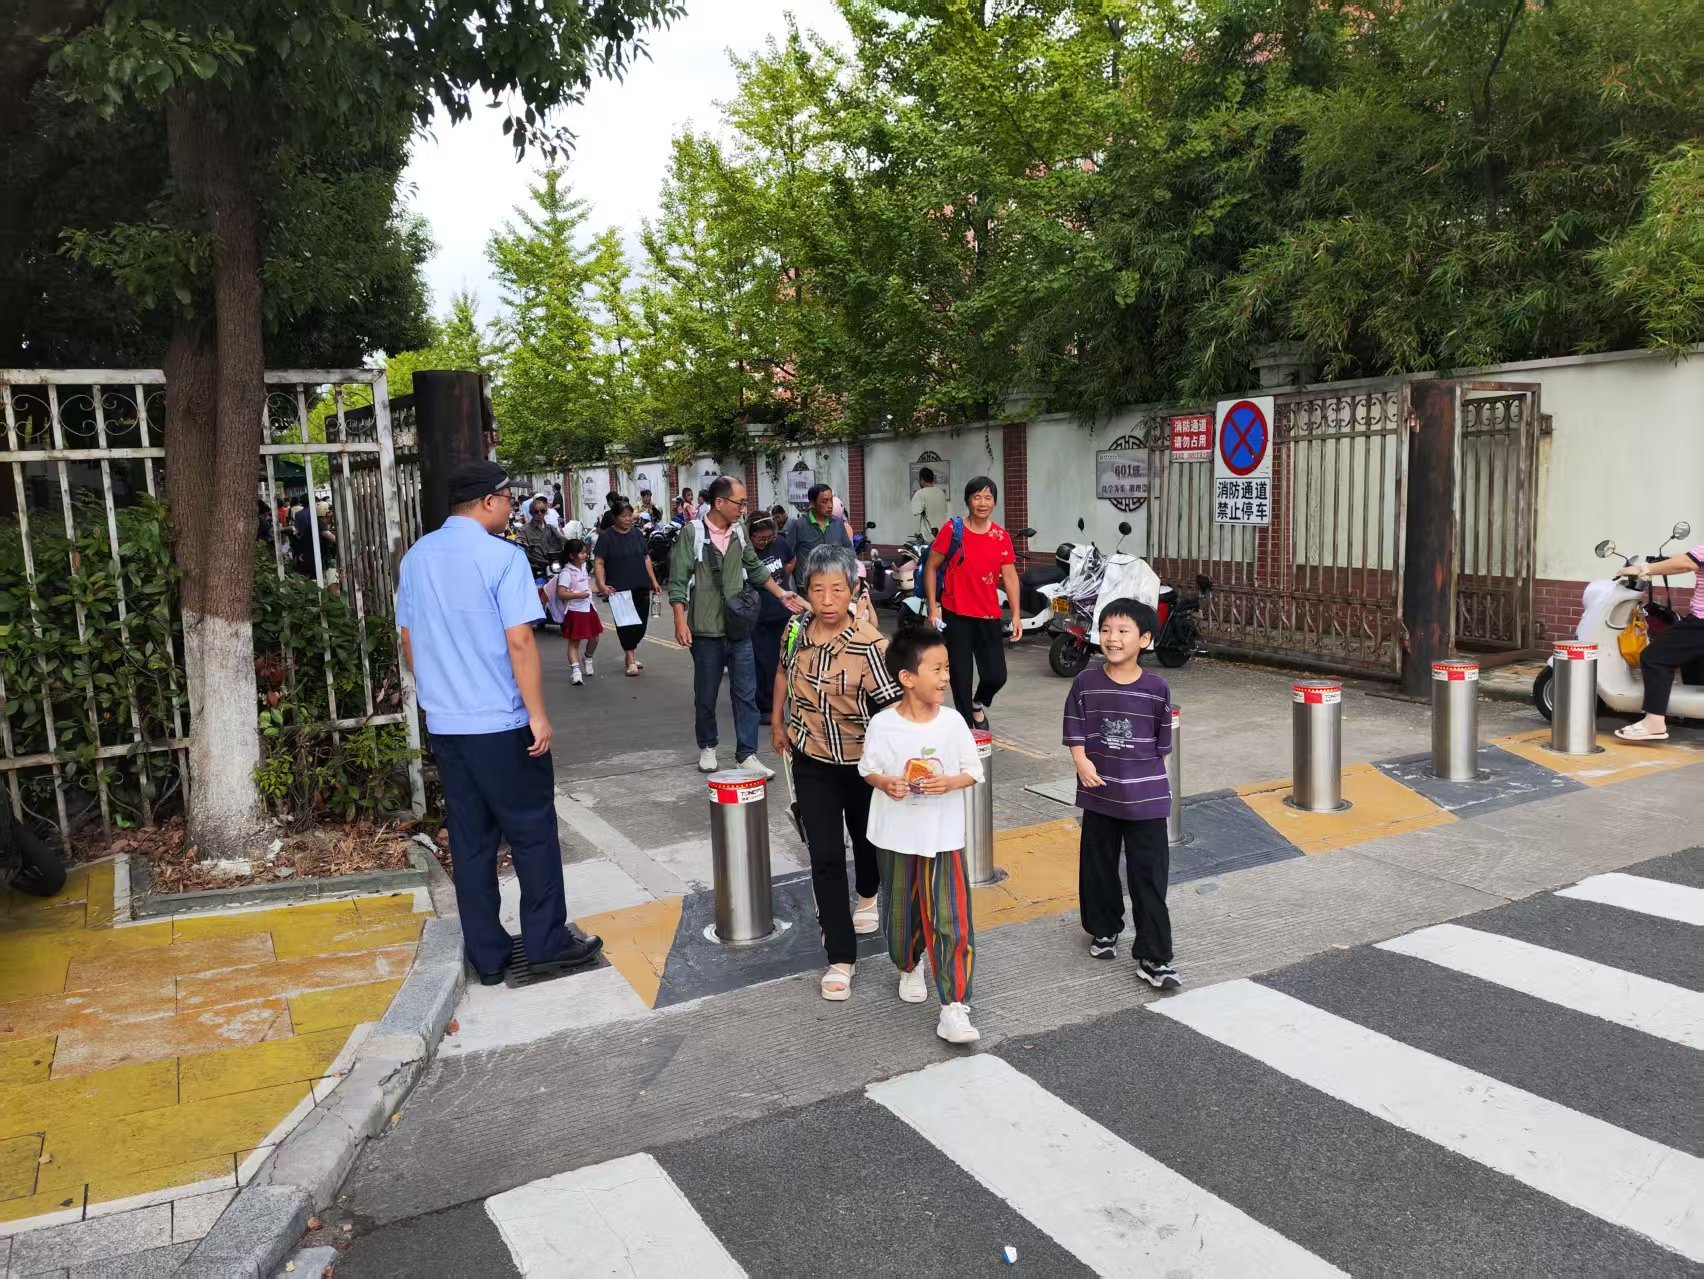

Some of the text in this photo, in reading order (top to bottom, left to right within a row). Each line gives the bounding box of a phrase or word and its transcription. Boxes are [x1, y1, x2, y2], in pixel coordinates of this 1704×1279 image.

[1174, 418, 1207, 433] 消防通道
[1174, 434, 1206, 448] 请勿占用
[1217, 481, 1268, 500] 消防通道
[1217, 501, 1268, 521] 禁止停车
